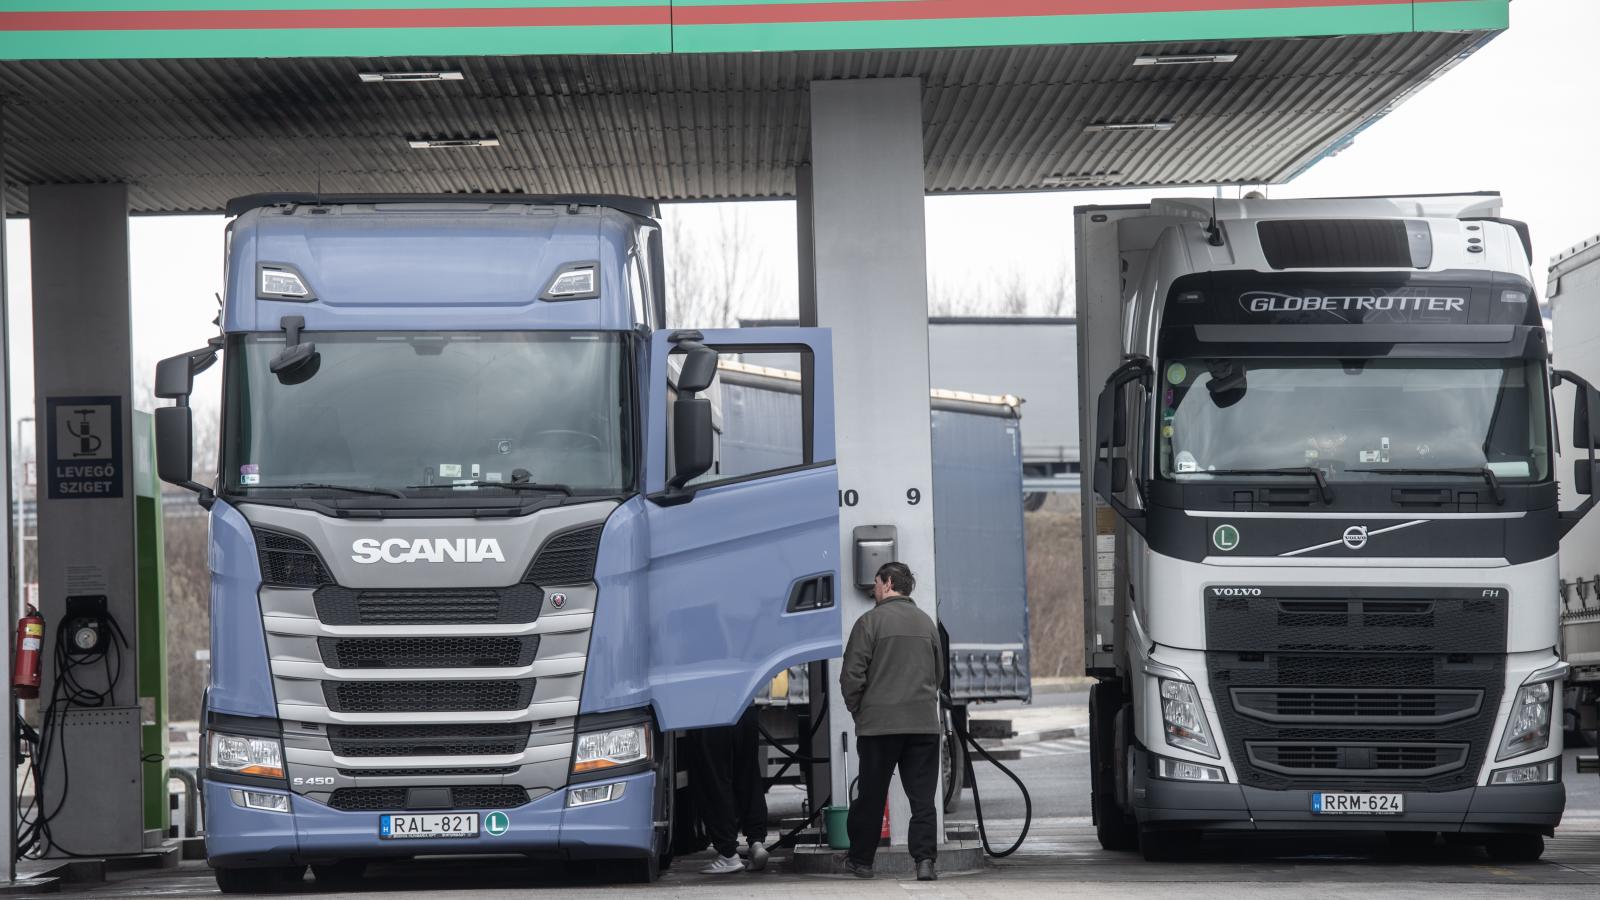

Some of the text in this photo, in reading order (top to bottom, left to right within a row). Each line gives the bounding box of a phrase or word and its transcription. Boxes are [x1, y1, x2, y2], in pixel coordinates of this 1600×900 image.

[1249, 296, 1465, 312] GLOBETROTTER
[56, 463, 115, 478] LEVEGŐ
[59, 481, 113, 494] SZIGET
[906, 487, 921, 506] 9
[1221, 529, 1233, 546] L
[351, 538, 506, 564] SCANIA
[1212, 588, 1262, 596] VOLVO
[1482, 589, 1499, 598] FH
[293, 777, 335, 786] S 450
[1325, 795, 1399, 810] RRM-624
[394, 816, 472, 833] RAL-821
[491, 815, 504, 832] L
